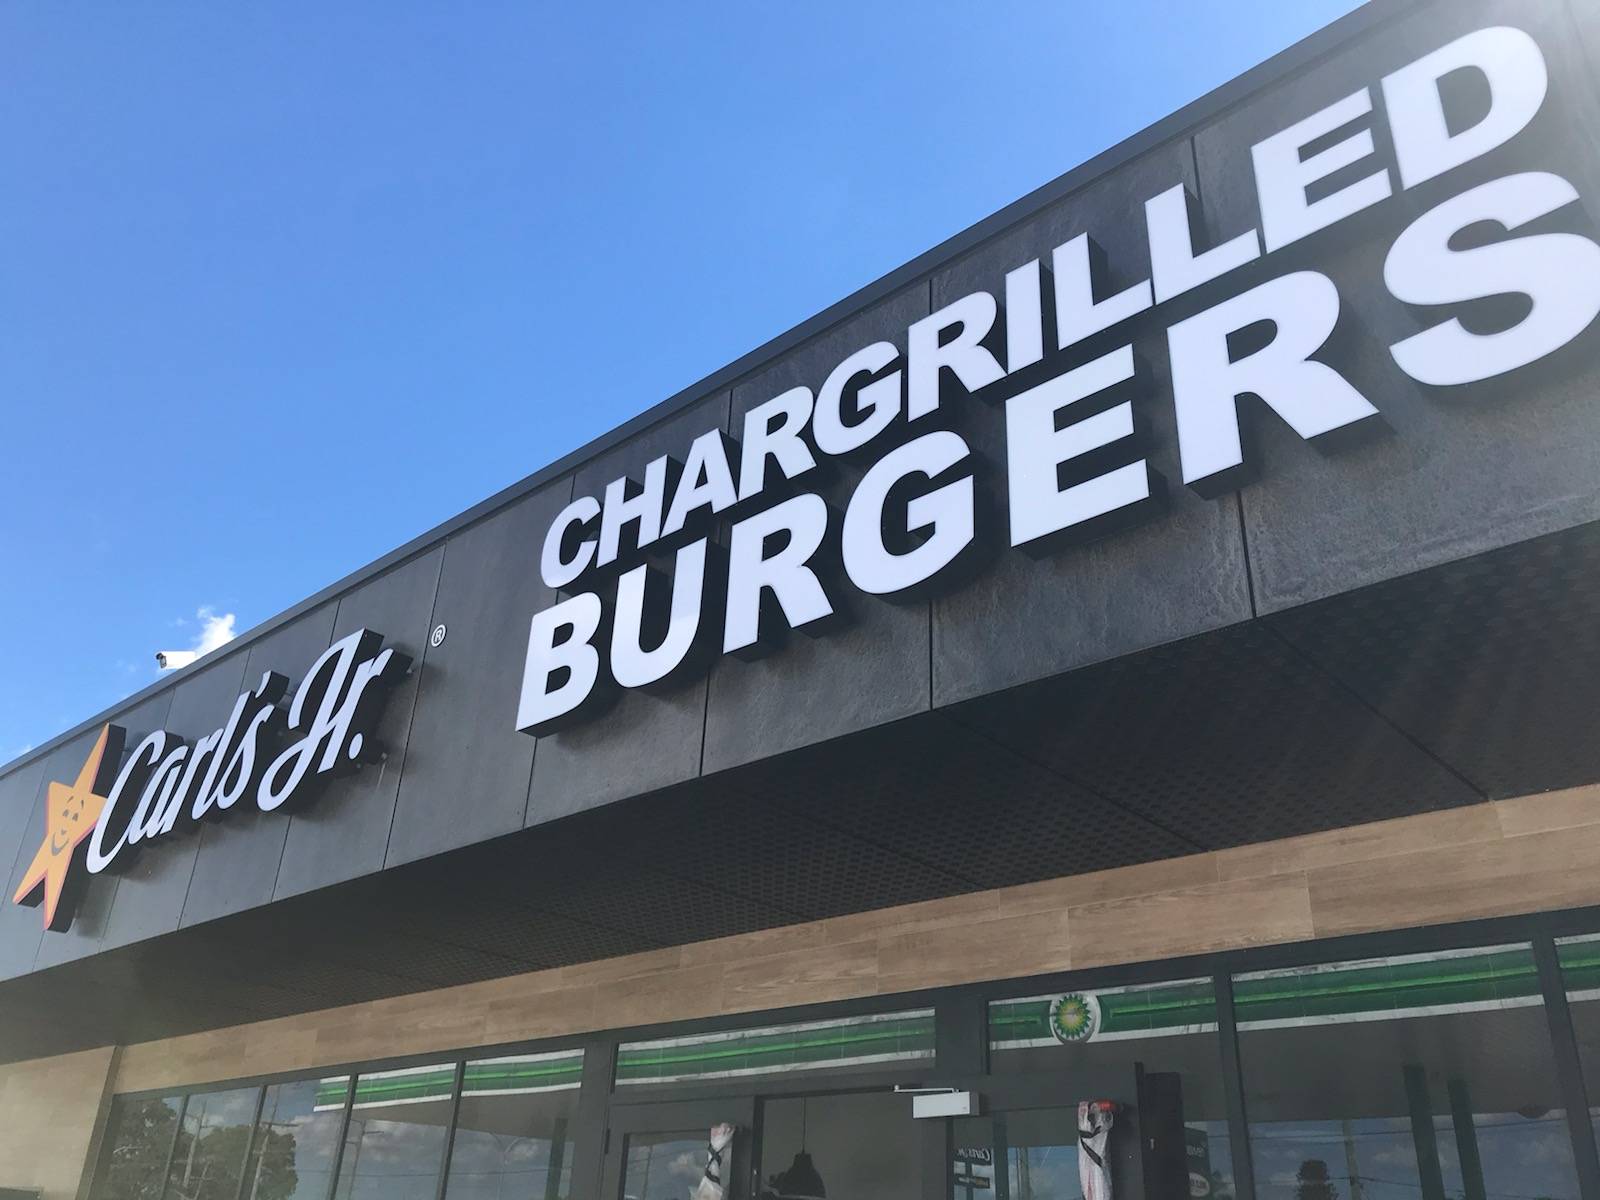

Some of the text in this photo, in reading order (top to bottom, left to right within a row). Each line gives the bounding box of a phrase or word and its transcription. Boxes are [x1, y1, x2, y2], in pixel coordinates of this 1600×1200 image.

[515, 171, 1600, 732] BURGERS
[541, 26, 1548, 588] CHARGRILLED
[86, 670, 276, 874] Carl's
[257, 628, 394, 811] Jr.
